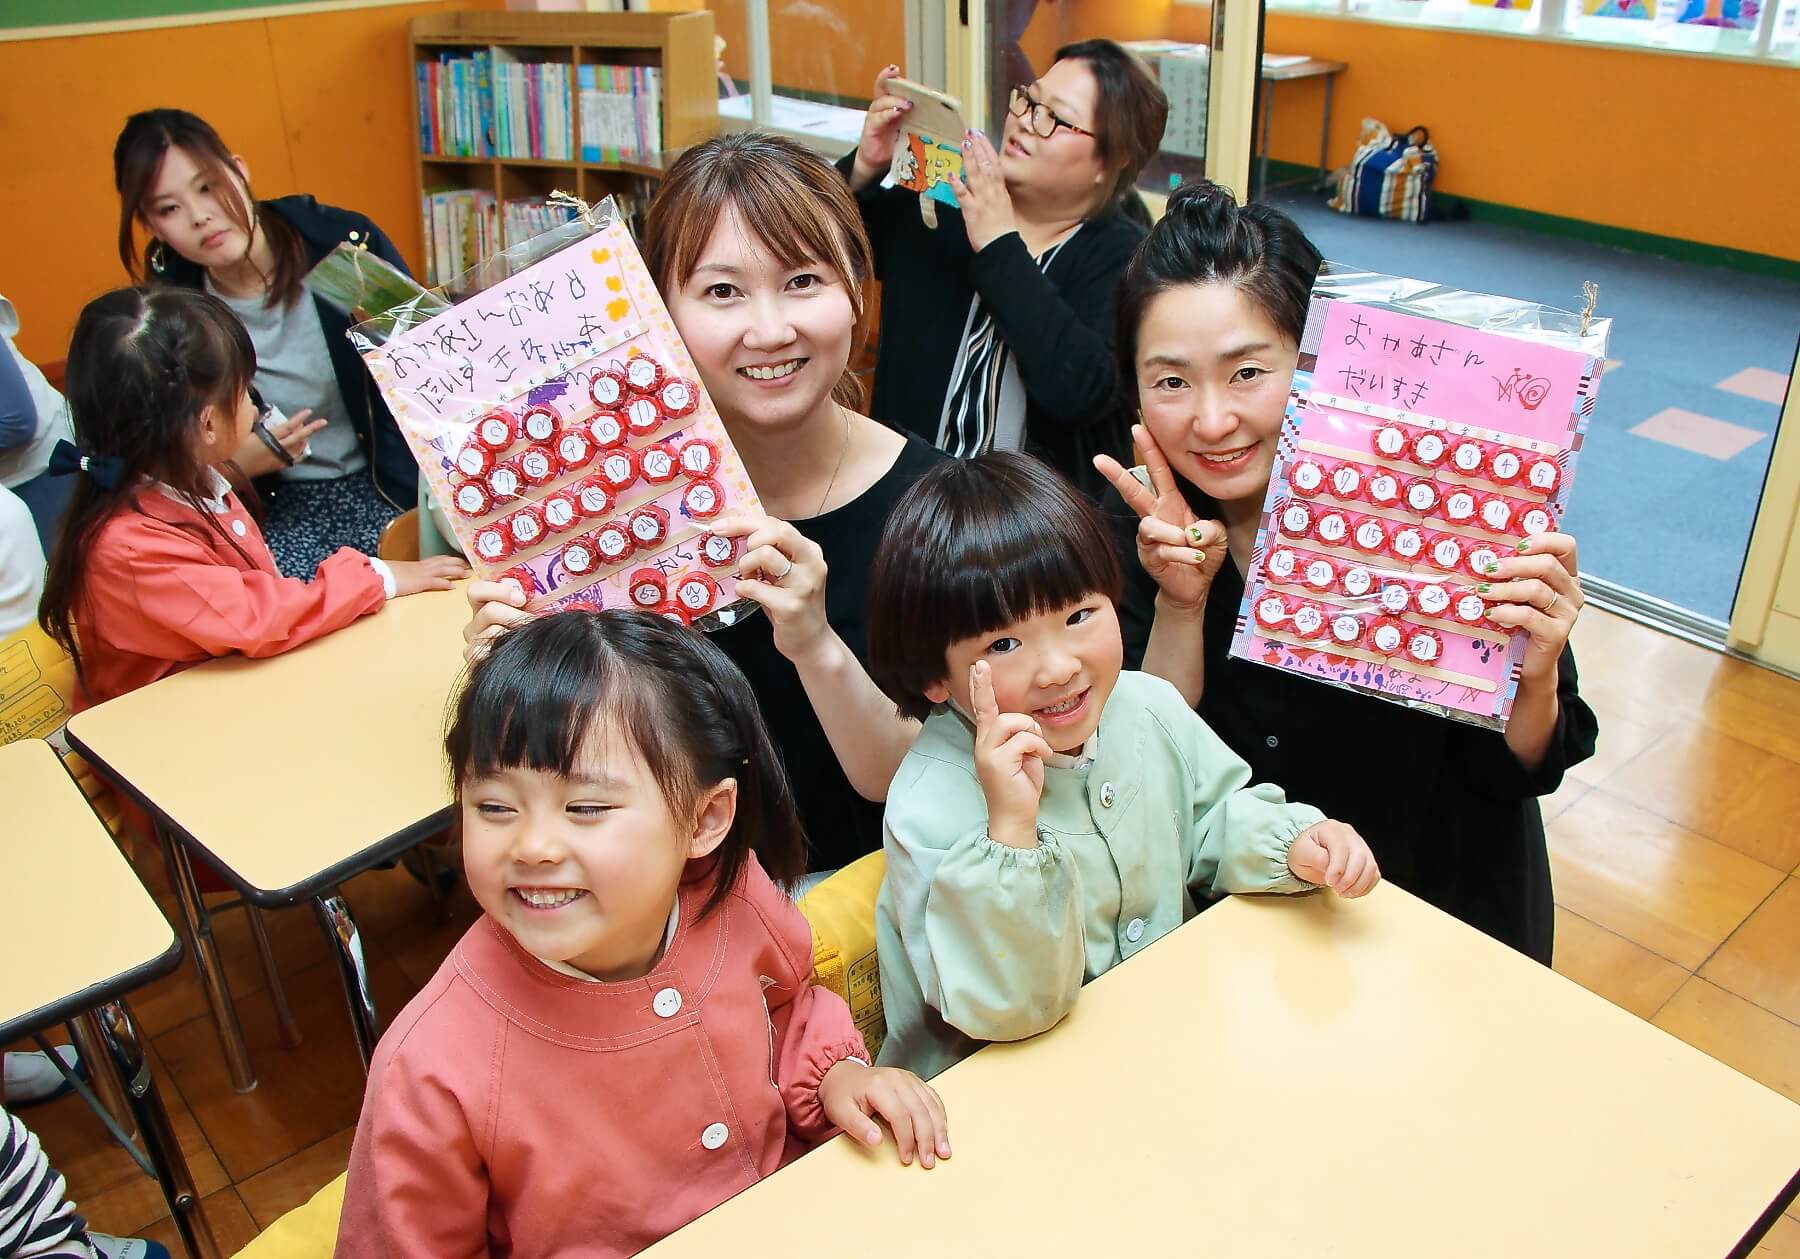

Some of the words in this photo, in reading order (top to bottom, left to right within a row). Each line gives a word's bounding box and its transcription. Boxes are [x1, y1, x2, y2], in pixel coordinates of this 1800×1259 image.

[1344, 313, 1486, 366] おかあさん
[1337, 364, 1430, 410] だいすき
[526, 457, 543, 476] 8
[562, 439, 577, 459] 9
[599, 421, 616, 439] 10
[610, 458, 627, 478] 17
[650, 453, 668, 474] 18
[1425, 441, 1435, 451] 2
[1464, 449, 1473, 466] 3
[1501, 458, 1513, 474] 4
[1537, 468, 1546, 484] 5
[1302, 472, 1311, 482] 6
[1340, 471, 1352, 490] 7
[1377, 480, 1388, 493] 8
[1418, 491, 1426, 503] 9
[1454, 498, 1468, 510] 10
[1494, 504, 1506, 516] 11
[1530, 515, 1546, 526] 12
[601, 534, 623, 550] 23
[637, 517, 657, 533] 24
[1293, 511, 1305, 526] 13
[1328, 519, 1340, 534] 14
[1364, 526, 1381, 544] 15
[1401, 537, 1414, 549] 16
[1442, 544, 1456, 559] 17
[1311, 566, 1326, 579] 21
[1349, 572, 1369, 584] 22
[1425, 590, 1445, 604] 24
[1263, 601, 1283, 614] 27
[1299, 609, 1319, 626] 28
[1412, 638, 1429, 656] 31
